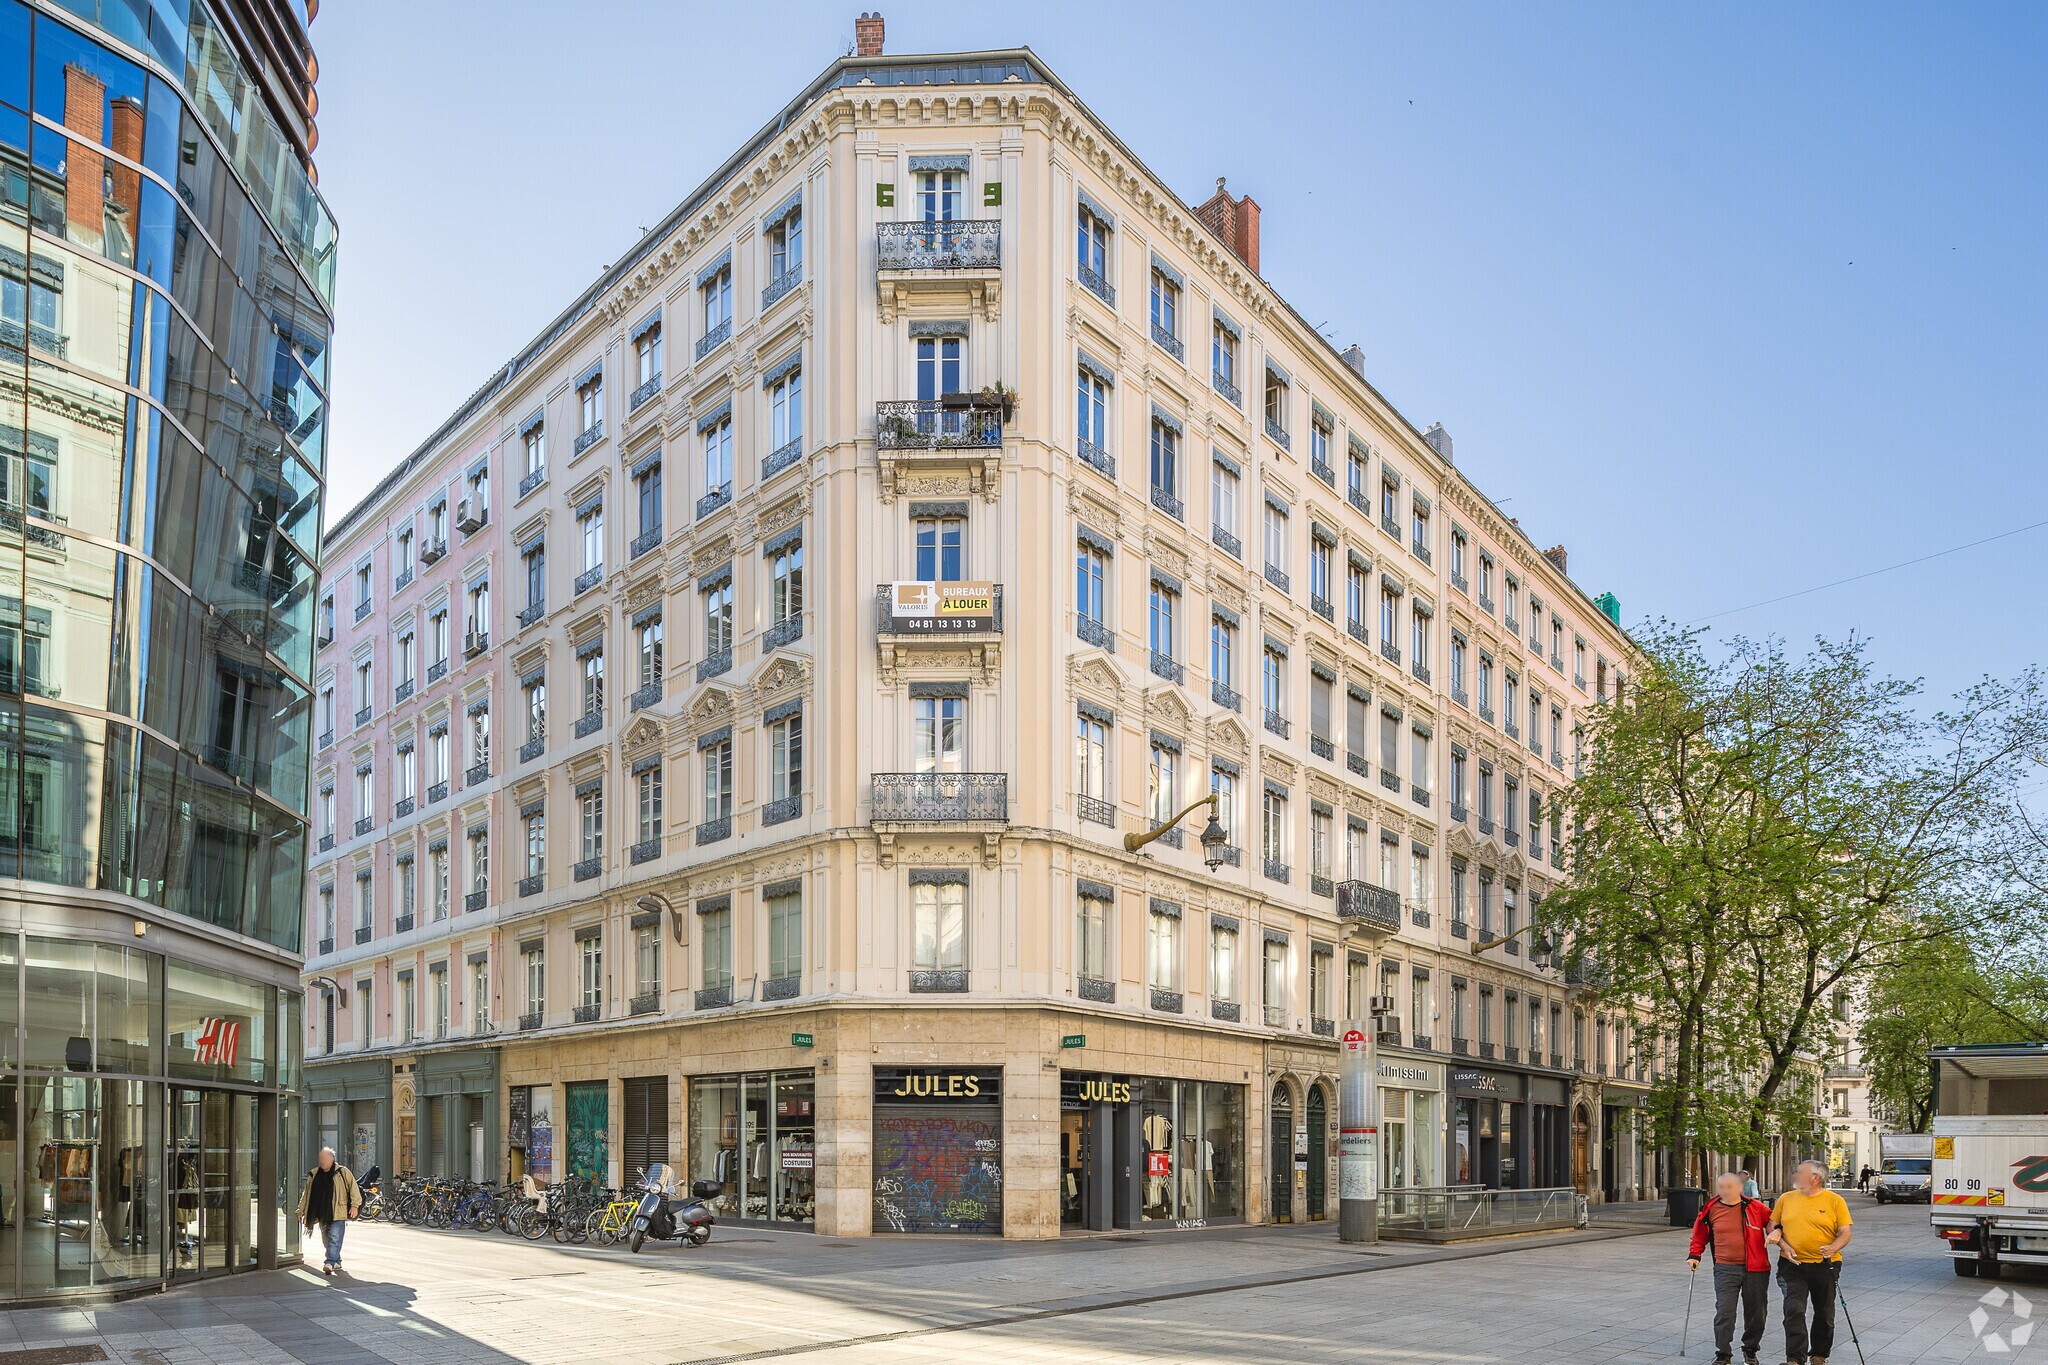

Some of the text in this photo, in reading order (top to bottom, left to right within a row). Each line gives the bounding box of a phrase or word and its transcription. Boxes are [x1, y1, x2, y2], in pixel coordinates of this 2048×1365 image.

[877, 182, 1002, 207] 6 9
[943, 587, 988, 596] BUREAUX
[943, 597, 988, 609] À LOUER
[909, 620, 976, 628] 04 81 13 13 13
[193, 1017, 240, 1068] H&M
[796, 1036, 812, 1044] JULES
[1065, 1037, 1081, 1045] JULES
[1347, 1033, 1359, 1041] M
[1377, 1062, 1429, 1081] timissimi
[895, 1075, 980, 1097] JULES
[1471, 1075, 1496, 1091] SSAC
[1079, 1080, 1131, 1103] JULES
[1340, 1136, 1371, 1145] ordeliers
[1944, 1178, 1980, 1191] 80 90
